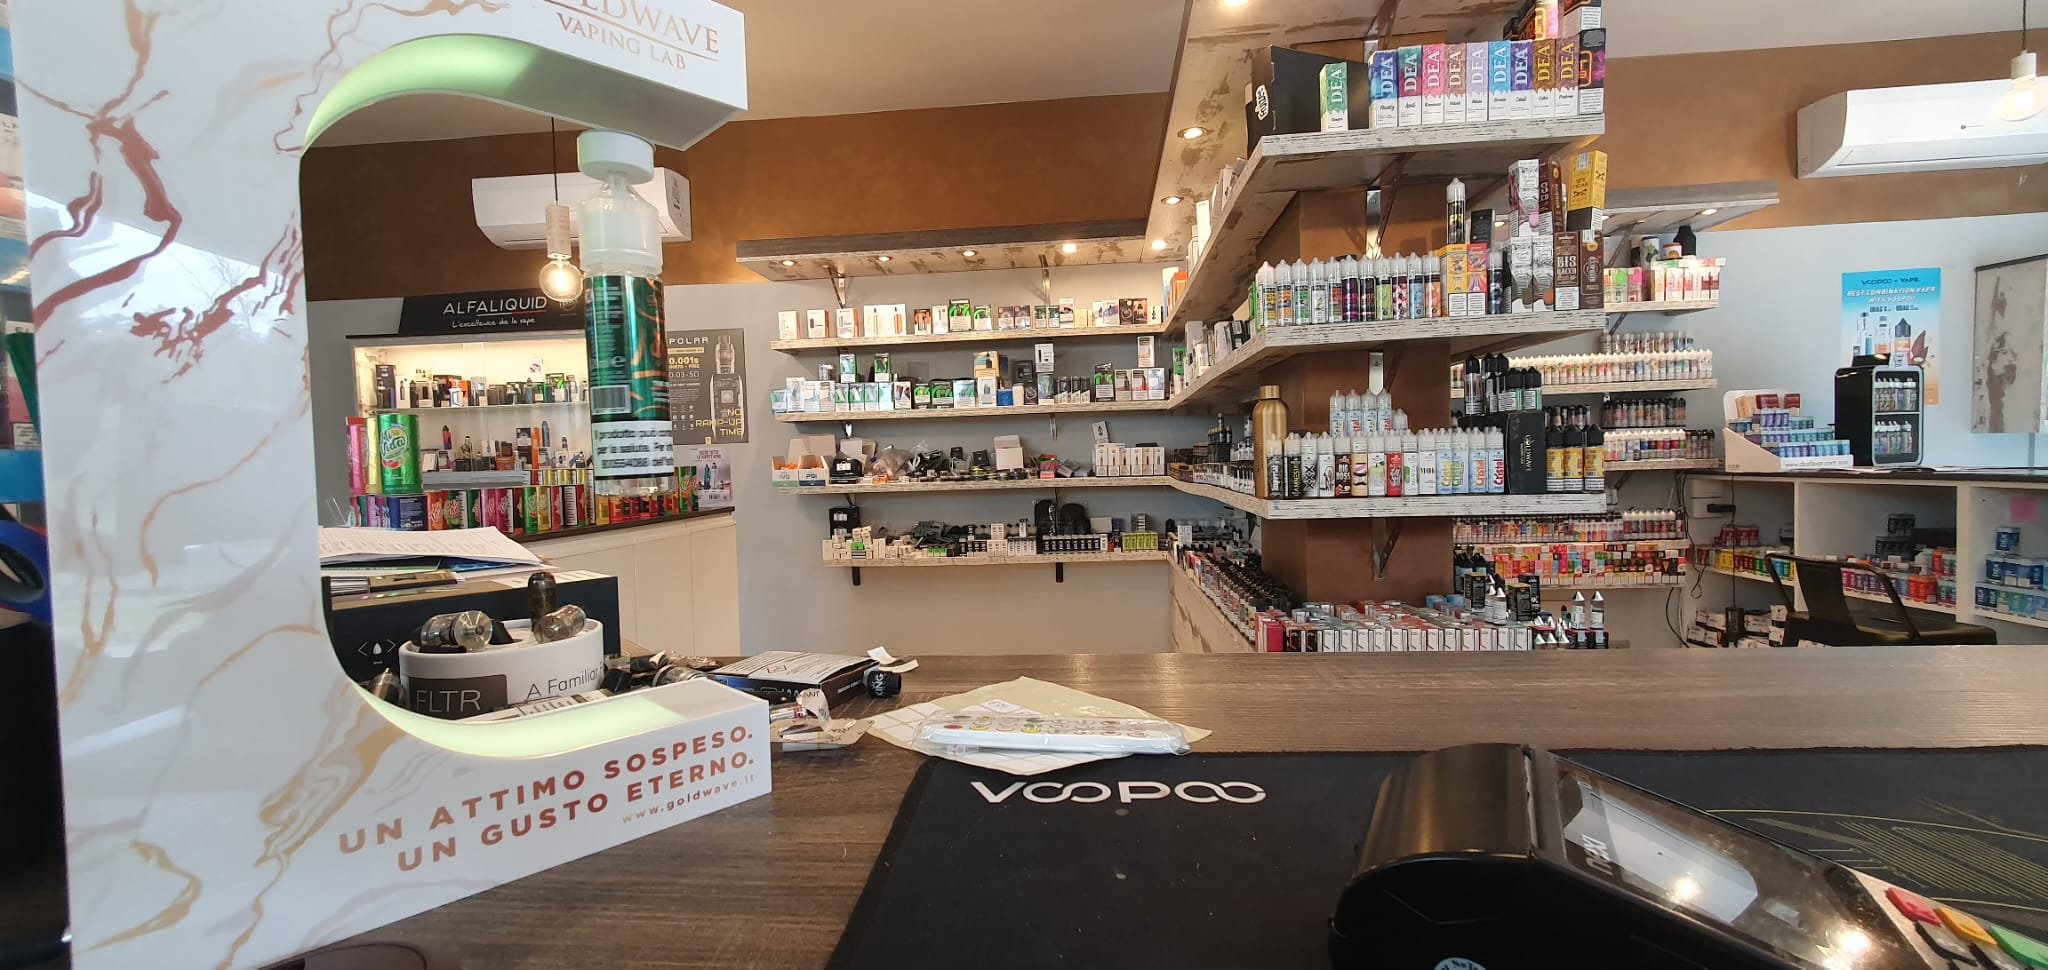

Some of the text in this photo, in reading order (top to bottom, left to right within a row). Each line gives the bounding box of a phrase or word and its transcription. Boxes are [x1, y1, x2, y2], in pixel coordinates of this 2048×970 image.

[556, 12, 686, 70] VAPING LAB
[1381, 56, 1394, 95] DEA
[1404, 53, 1417, 92] DEA
[1428, 50, 1440, 87] DEA
[1449, 50, 1463, 86] DEA
[1472, 48, 1483, 84] DEA
[1494, 46, 1507, 83] DEA
[1515, 47, 1528, 85] DEA
[1538, 45, 1551, 81] DEA
[1561, 42, 1575, 80] DEA
[1330, 67, 1342, 103] DEA
[443, 297, 548, 315] ALFALIQUID
[668, 336, 709, 345] POLAR
[727, 408, 742, 417] NO
[416, 689, 482, 713] FLTR
[526, 668, 600, 699] A Familiar
[876, 673, 884, 697] KING
[339, 725, 753, 855] UN ATTIMO SOSPESO.
[622, 773, 755, 824] www.goldwave.it
[970, 781, 1267, 804] VOOPOO
[397, 751, 754, 872] UN GUSTO ETERNO.
